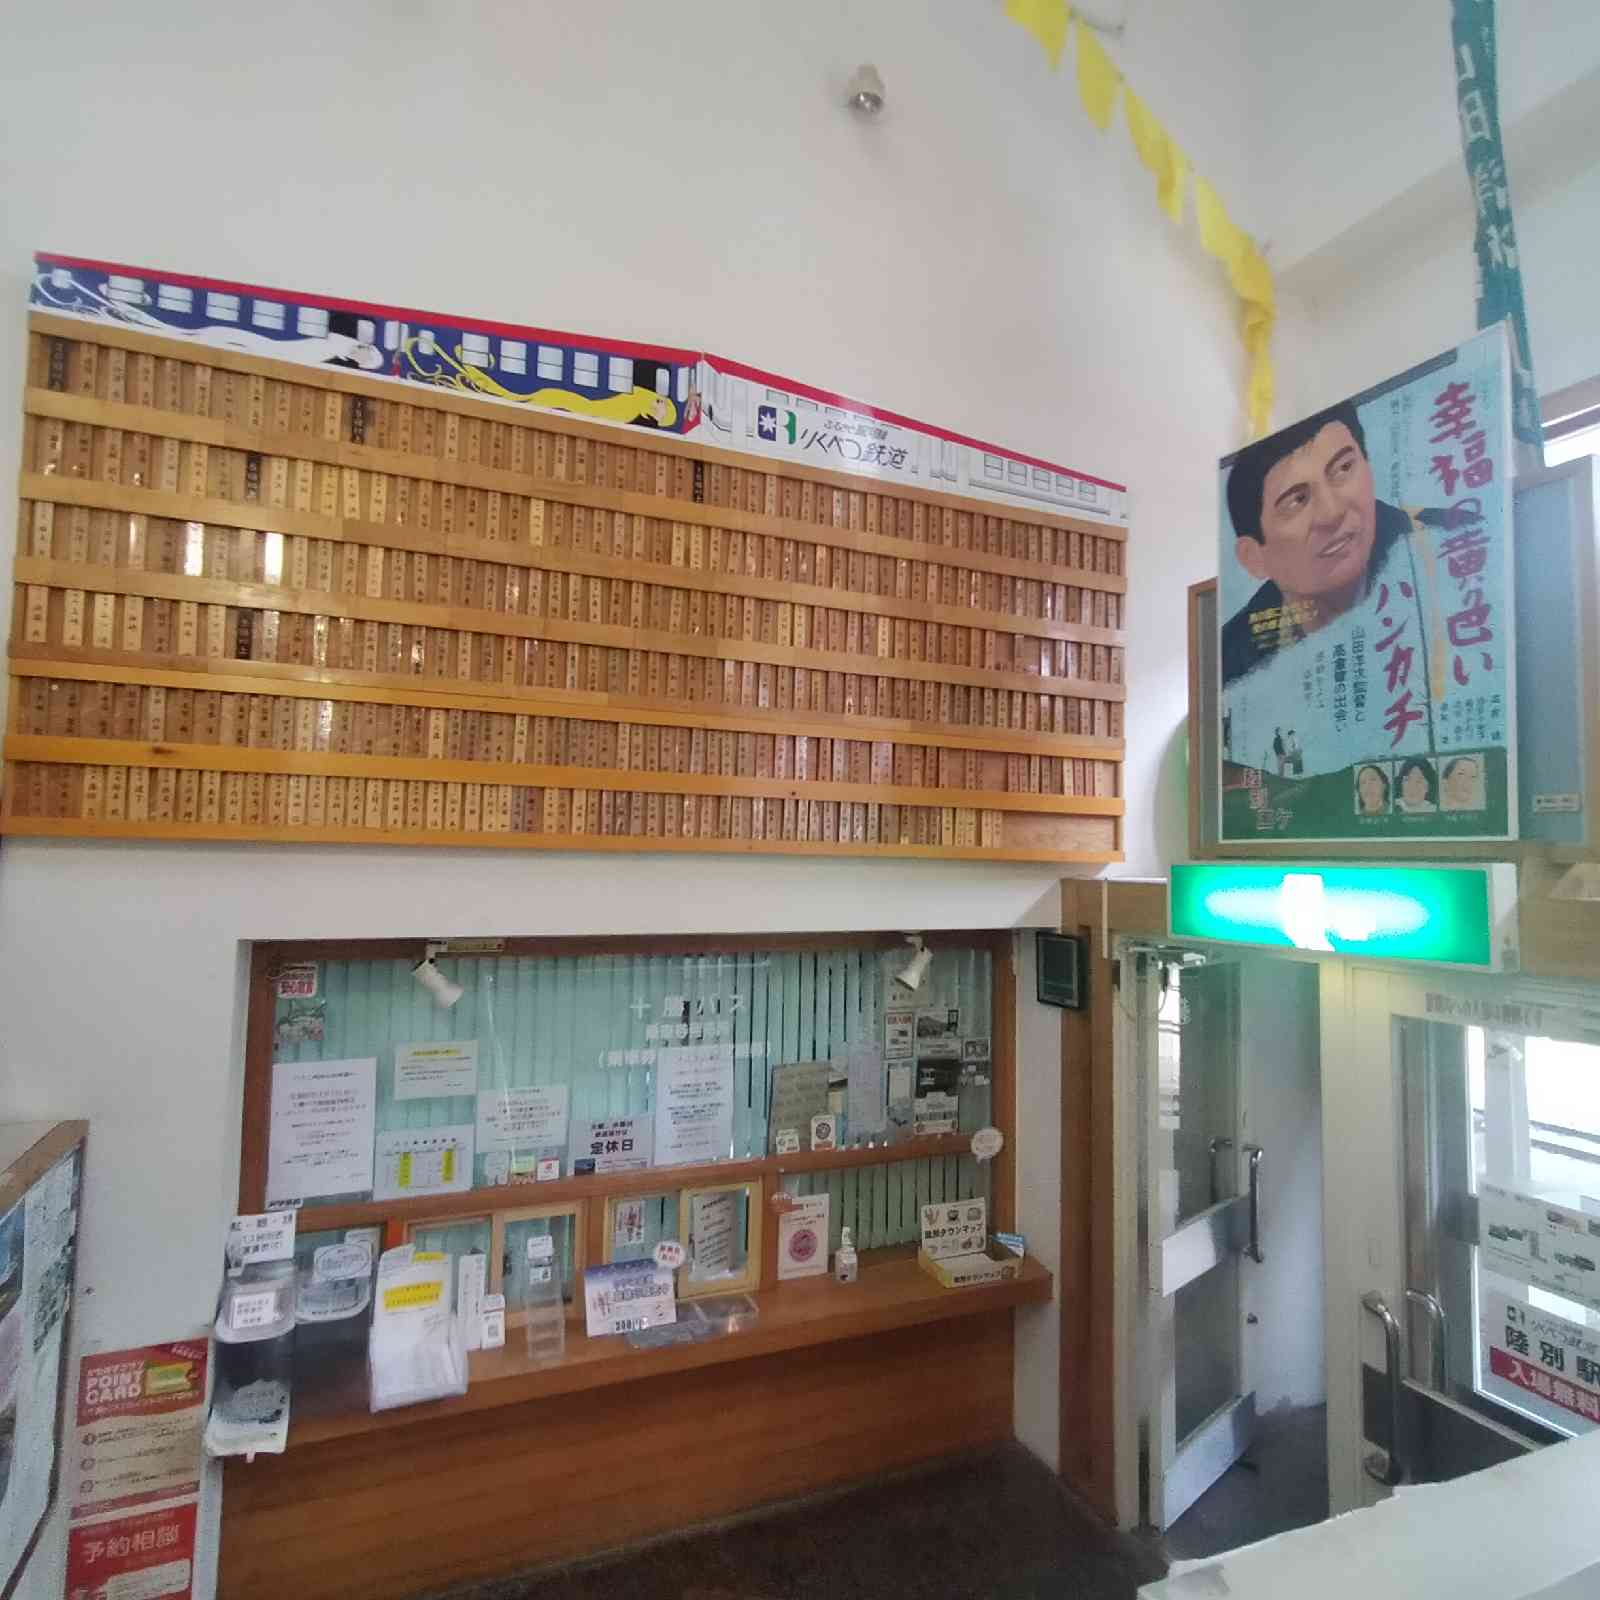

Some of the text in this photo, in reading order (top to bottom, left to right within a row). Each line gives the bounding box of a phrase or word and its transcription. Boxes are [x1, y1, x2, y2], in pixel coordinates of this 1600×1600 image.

[1373, 579, 1424, 750] ハンカチ
[590, 1138, 634, 1155] 定休日
